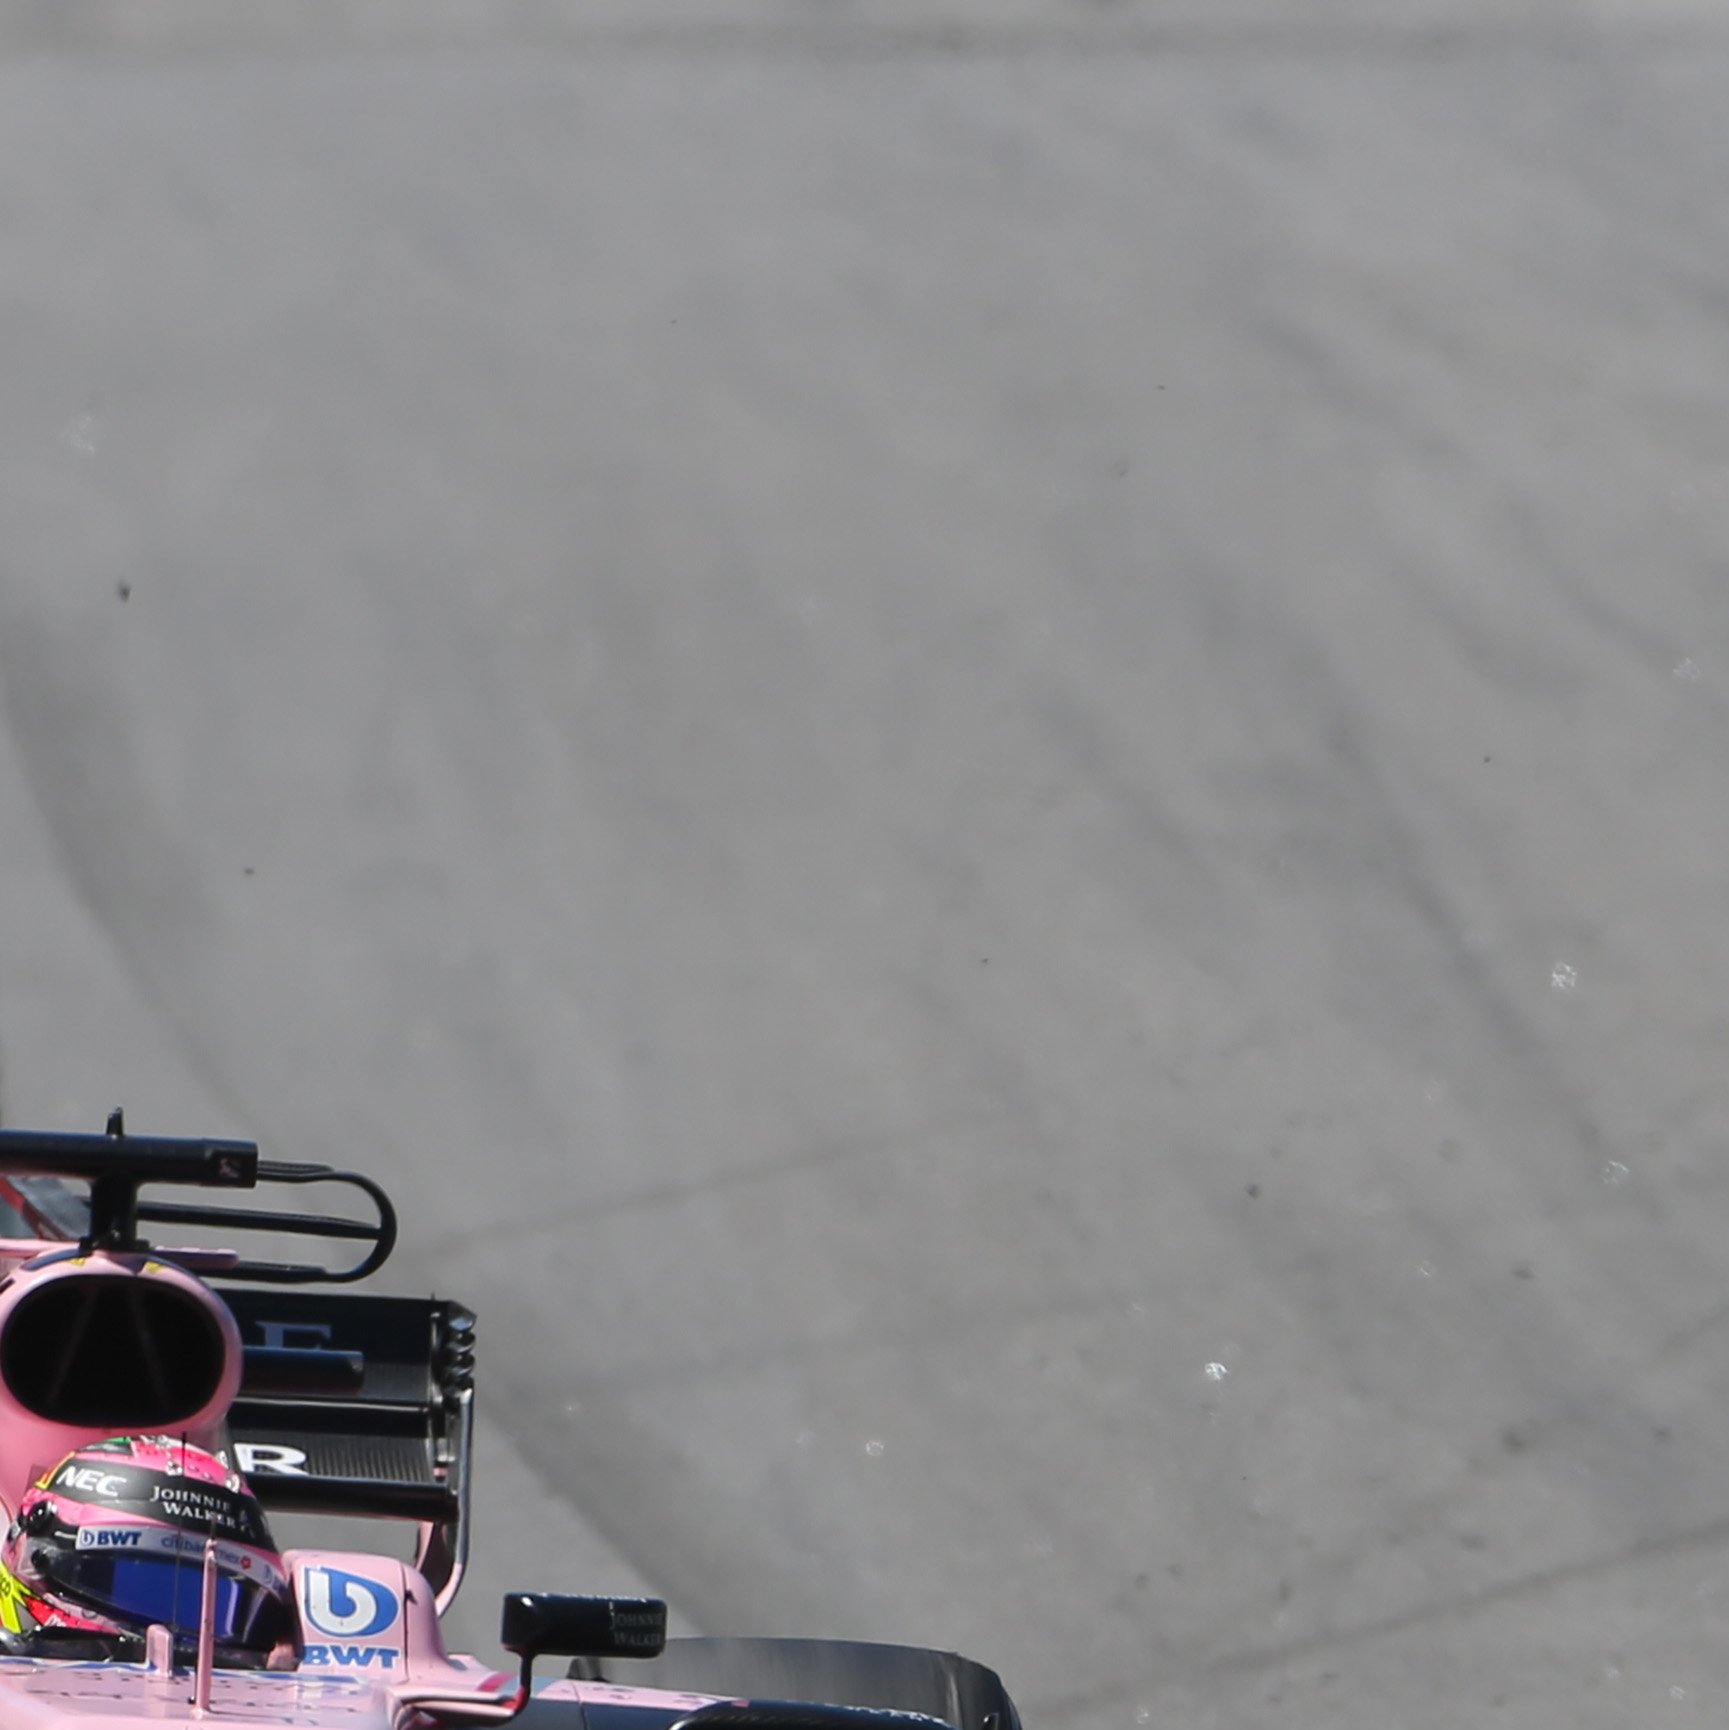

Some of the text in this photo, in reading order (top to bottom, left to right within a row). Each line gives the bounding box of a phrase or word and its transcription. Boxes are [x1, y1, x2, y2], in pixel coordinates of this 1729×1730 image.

[56, 1465, 127, 1497] NEC
[149, 1485, 233, 1514] JOHNNIE
[97, 1530, 142, 1547] BWT
[302, 1645, 399, 1668] BWT
